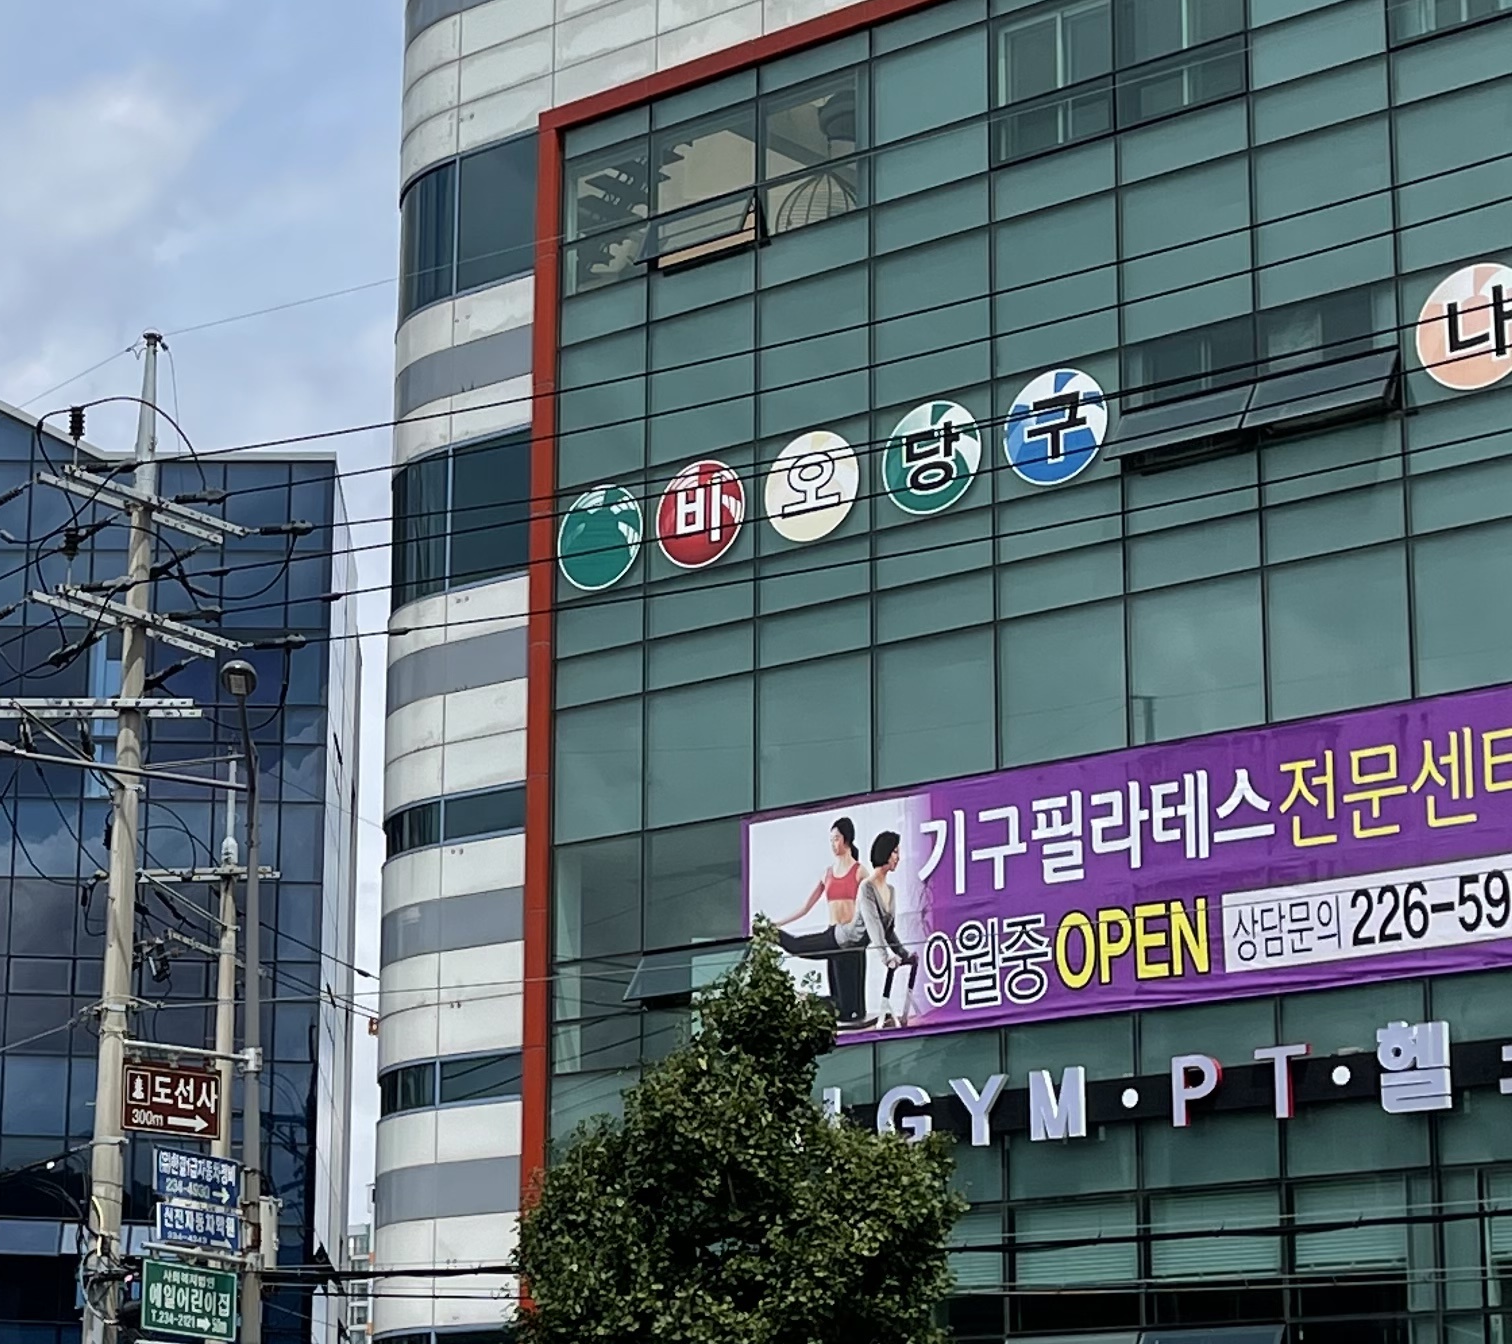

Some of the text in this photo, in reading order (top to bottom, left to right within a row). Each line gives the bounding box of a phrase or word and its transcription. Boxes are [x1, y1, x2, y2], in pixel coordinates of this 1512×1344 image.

[923, 896, 1210, 1010] 9월중 OPEN
[1232, 896, 1341, 963] 상담문의
[131, 1108, 164, 1127] 300m
[152, 1076, 219, 1114] 도선사
